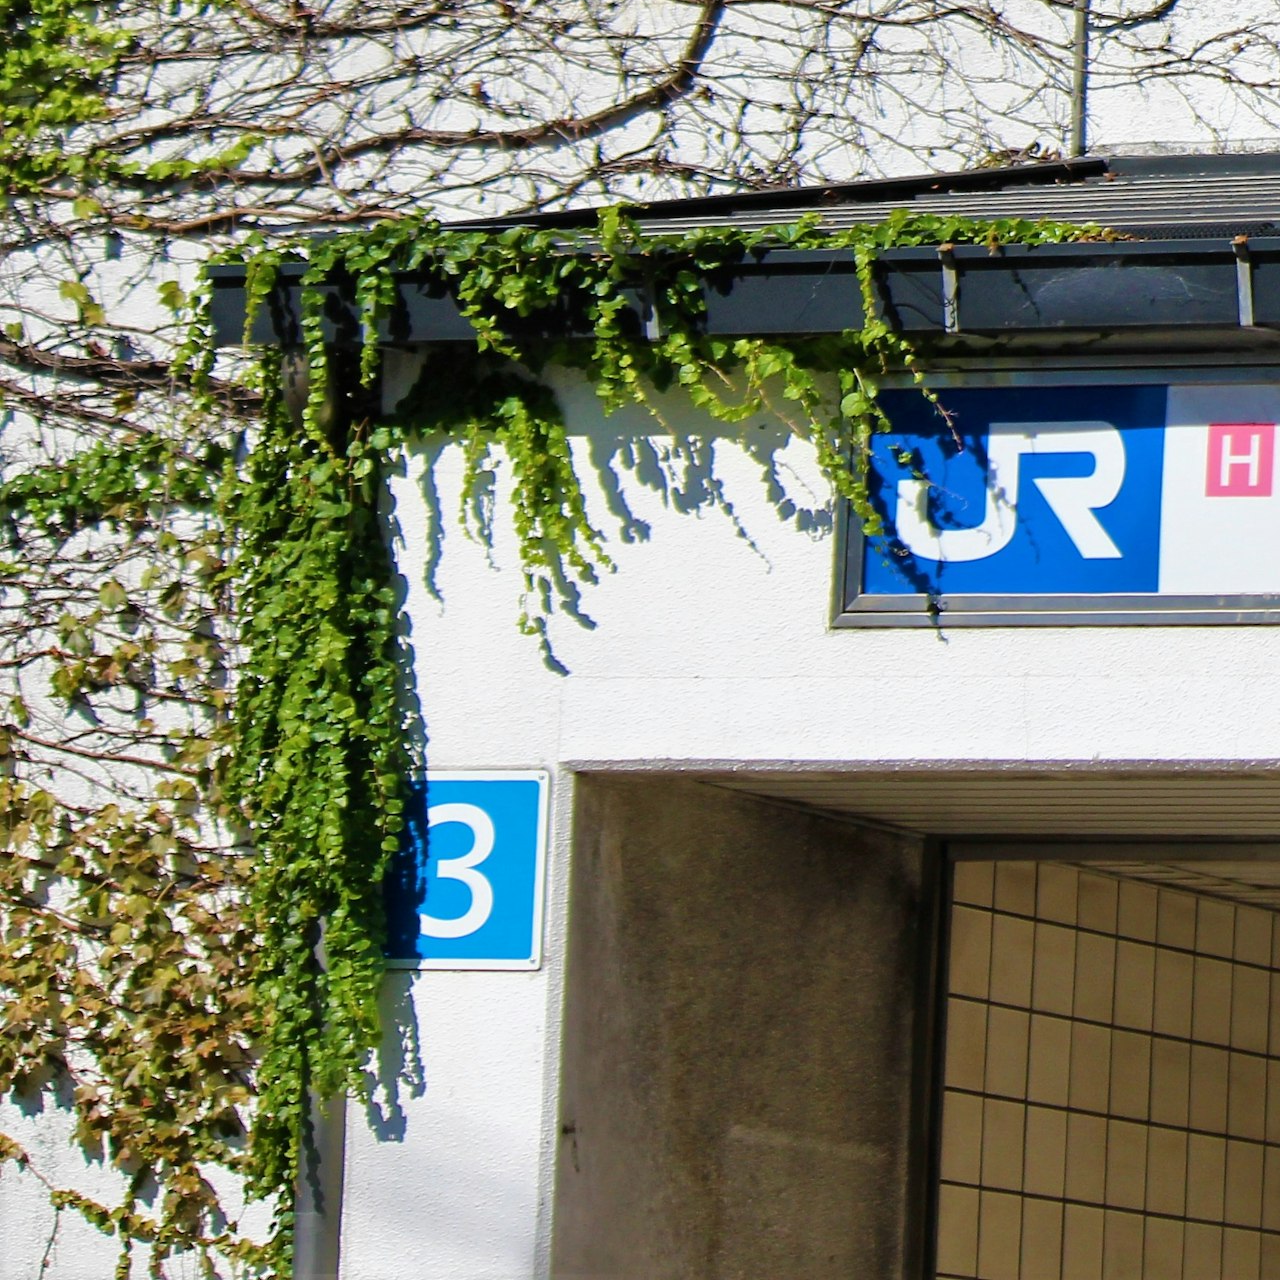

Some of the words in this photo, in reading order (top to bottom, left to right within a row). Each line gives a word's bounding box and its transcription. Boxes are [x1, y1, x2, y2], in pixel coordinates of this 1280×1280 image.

[896, 421, 1125, 562] JR
[1220, 434, 1259, 486] H
[420, 803, 495, 938] 3
